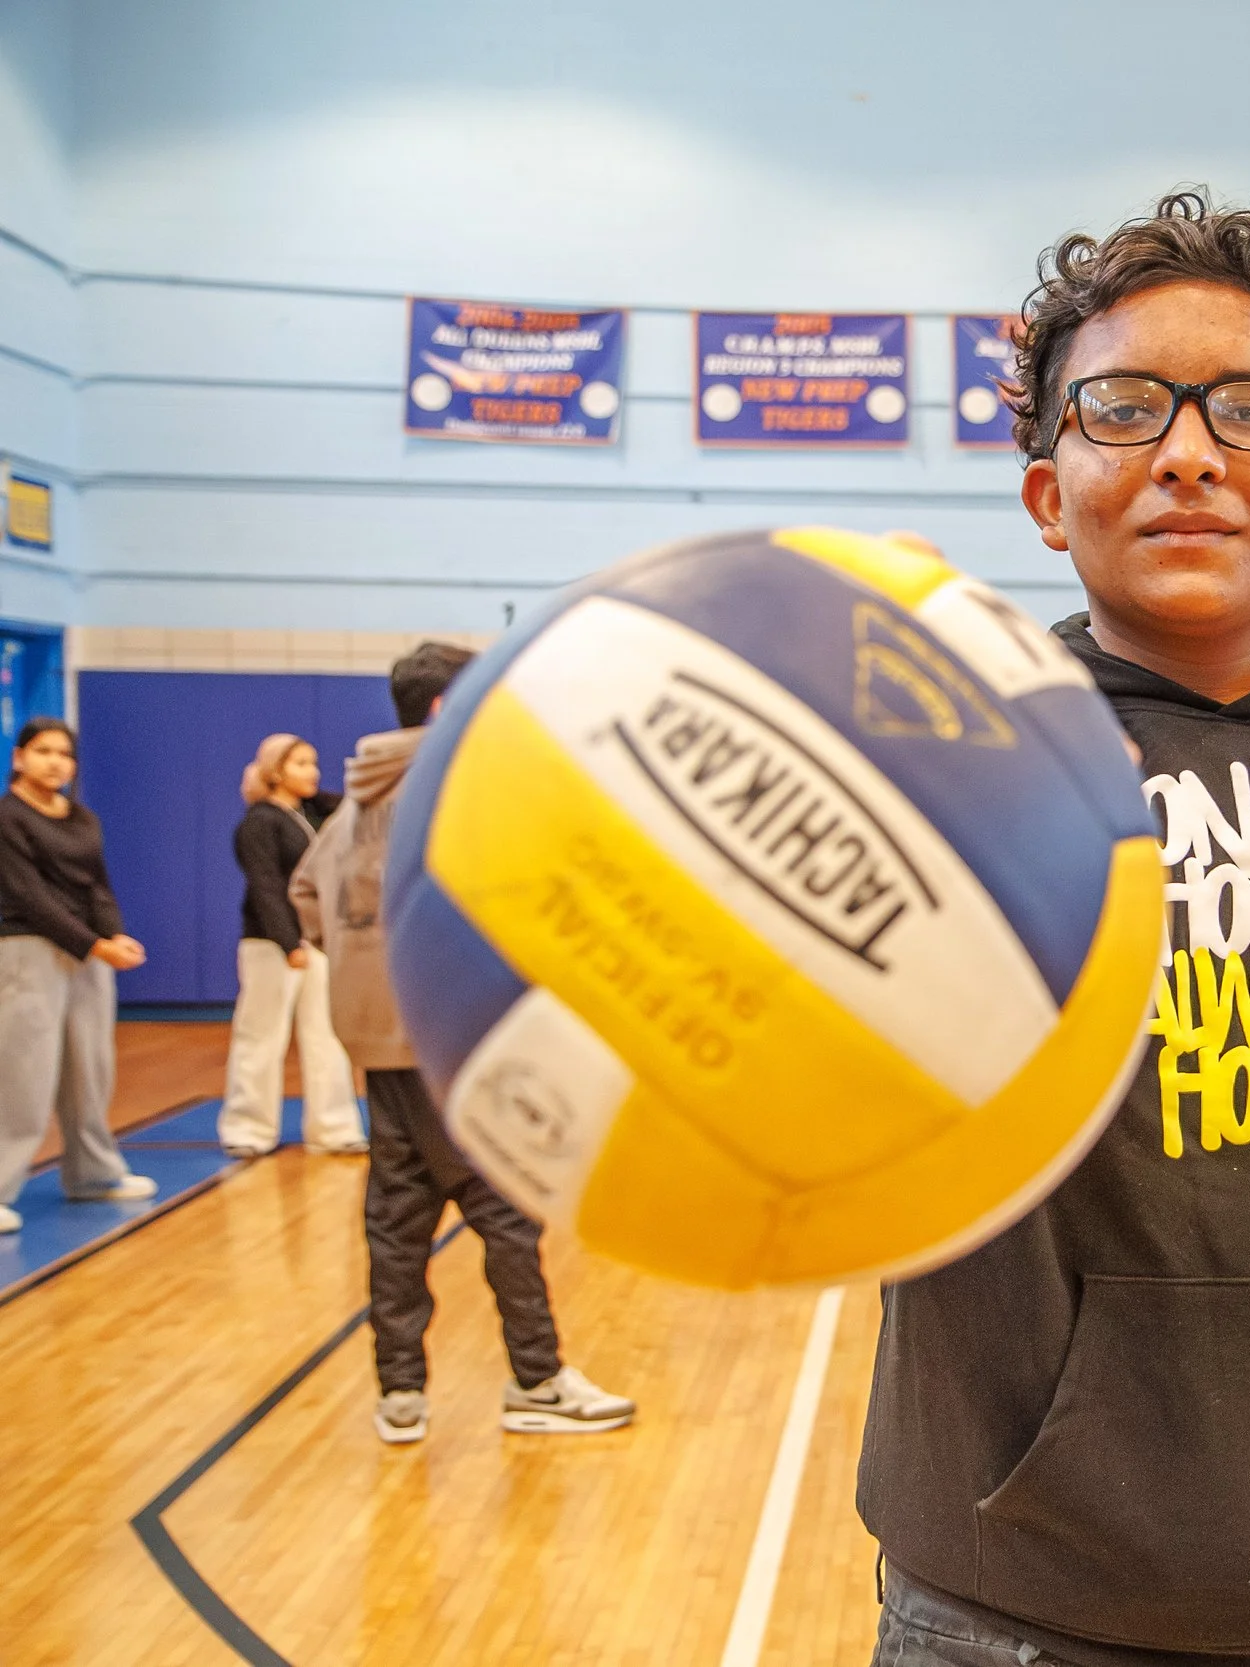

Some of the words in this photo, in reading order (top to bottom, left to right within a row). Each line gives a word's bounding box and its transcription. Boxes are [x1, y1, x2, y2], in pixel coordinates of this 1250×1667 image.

[741, 378, 800, 402] NEW
[802, 378, 869, 403] PREP
[471, 398, 562, 424] TIGERS
[761, 406, 849, 431] TIGERS
[635, 690, 915, 973] TACHIKARA
[535, 873, 735, 1071] OFFICIAL
